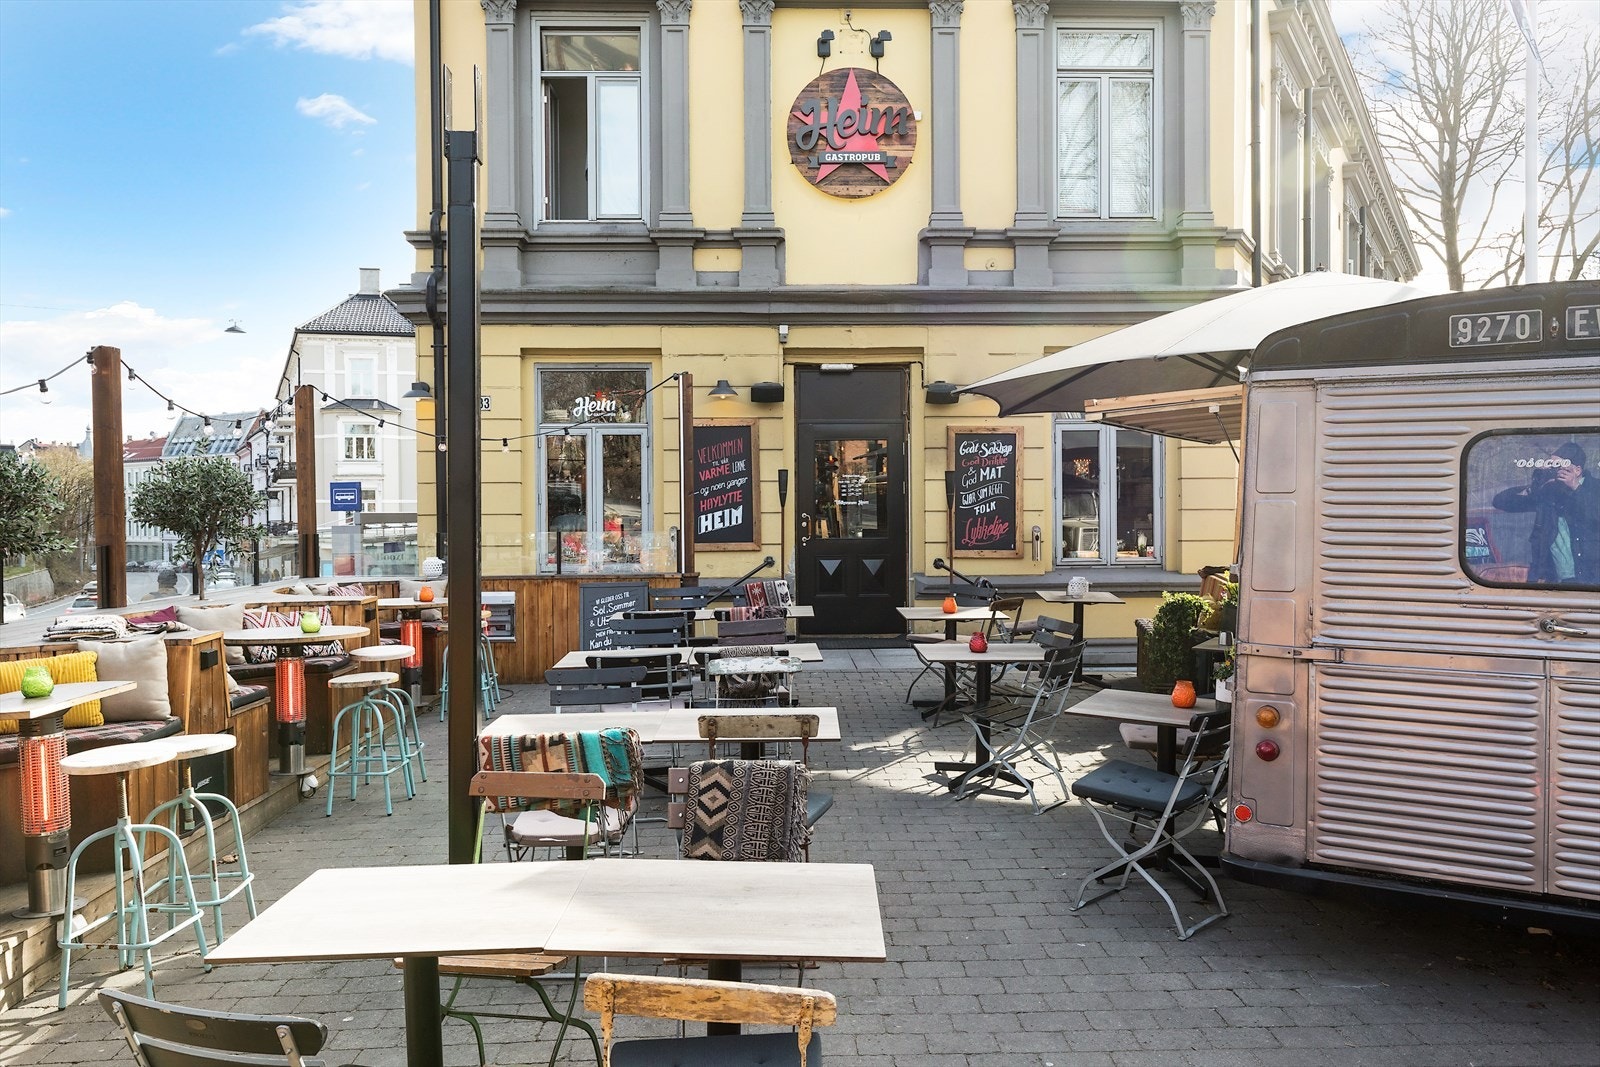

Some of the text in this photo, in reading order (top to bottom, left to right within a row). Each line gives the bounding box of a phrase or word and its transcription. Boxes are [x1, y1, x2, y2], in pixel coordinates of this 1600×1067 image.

[795, 94, 909, 150] Heim
[825, 153, 881, 161] GASTROPUB
[1457, 309, 1600, 344] 9270 E
[573, 396, 616, 417] Heim
[697, 438, 743, 464] VELKOMMEN
[959, 440, 979, 456] Godt
[961, 456, 980, 467] God
[711, 483, 725, 491] noen
[727, 477, 748, 489] ganger
[961, 473, 977, 488] God
[980, 466, 1006, 482] MAT
[700, 490, 743, 512] HØYLYTTE
[973, 501, 997, 516] FOLK
[697, 505, 742, 535] HEIM
[608, 600, 636, 612] Sommer
[589, 639, 603, 650] Kan
[603, 636, 612, 646] du
